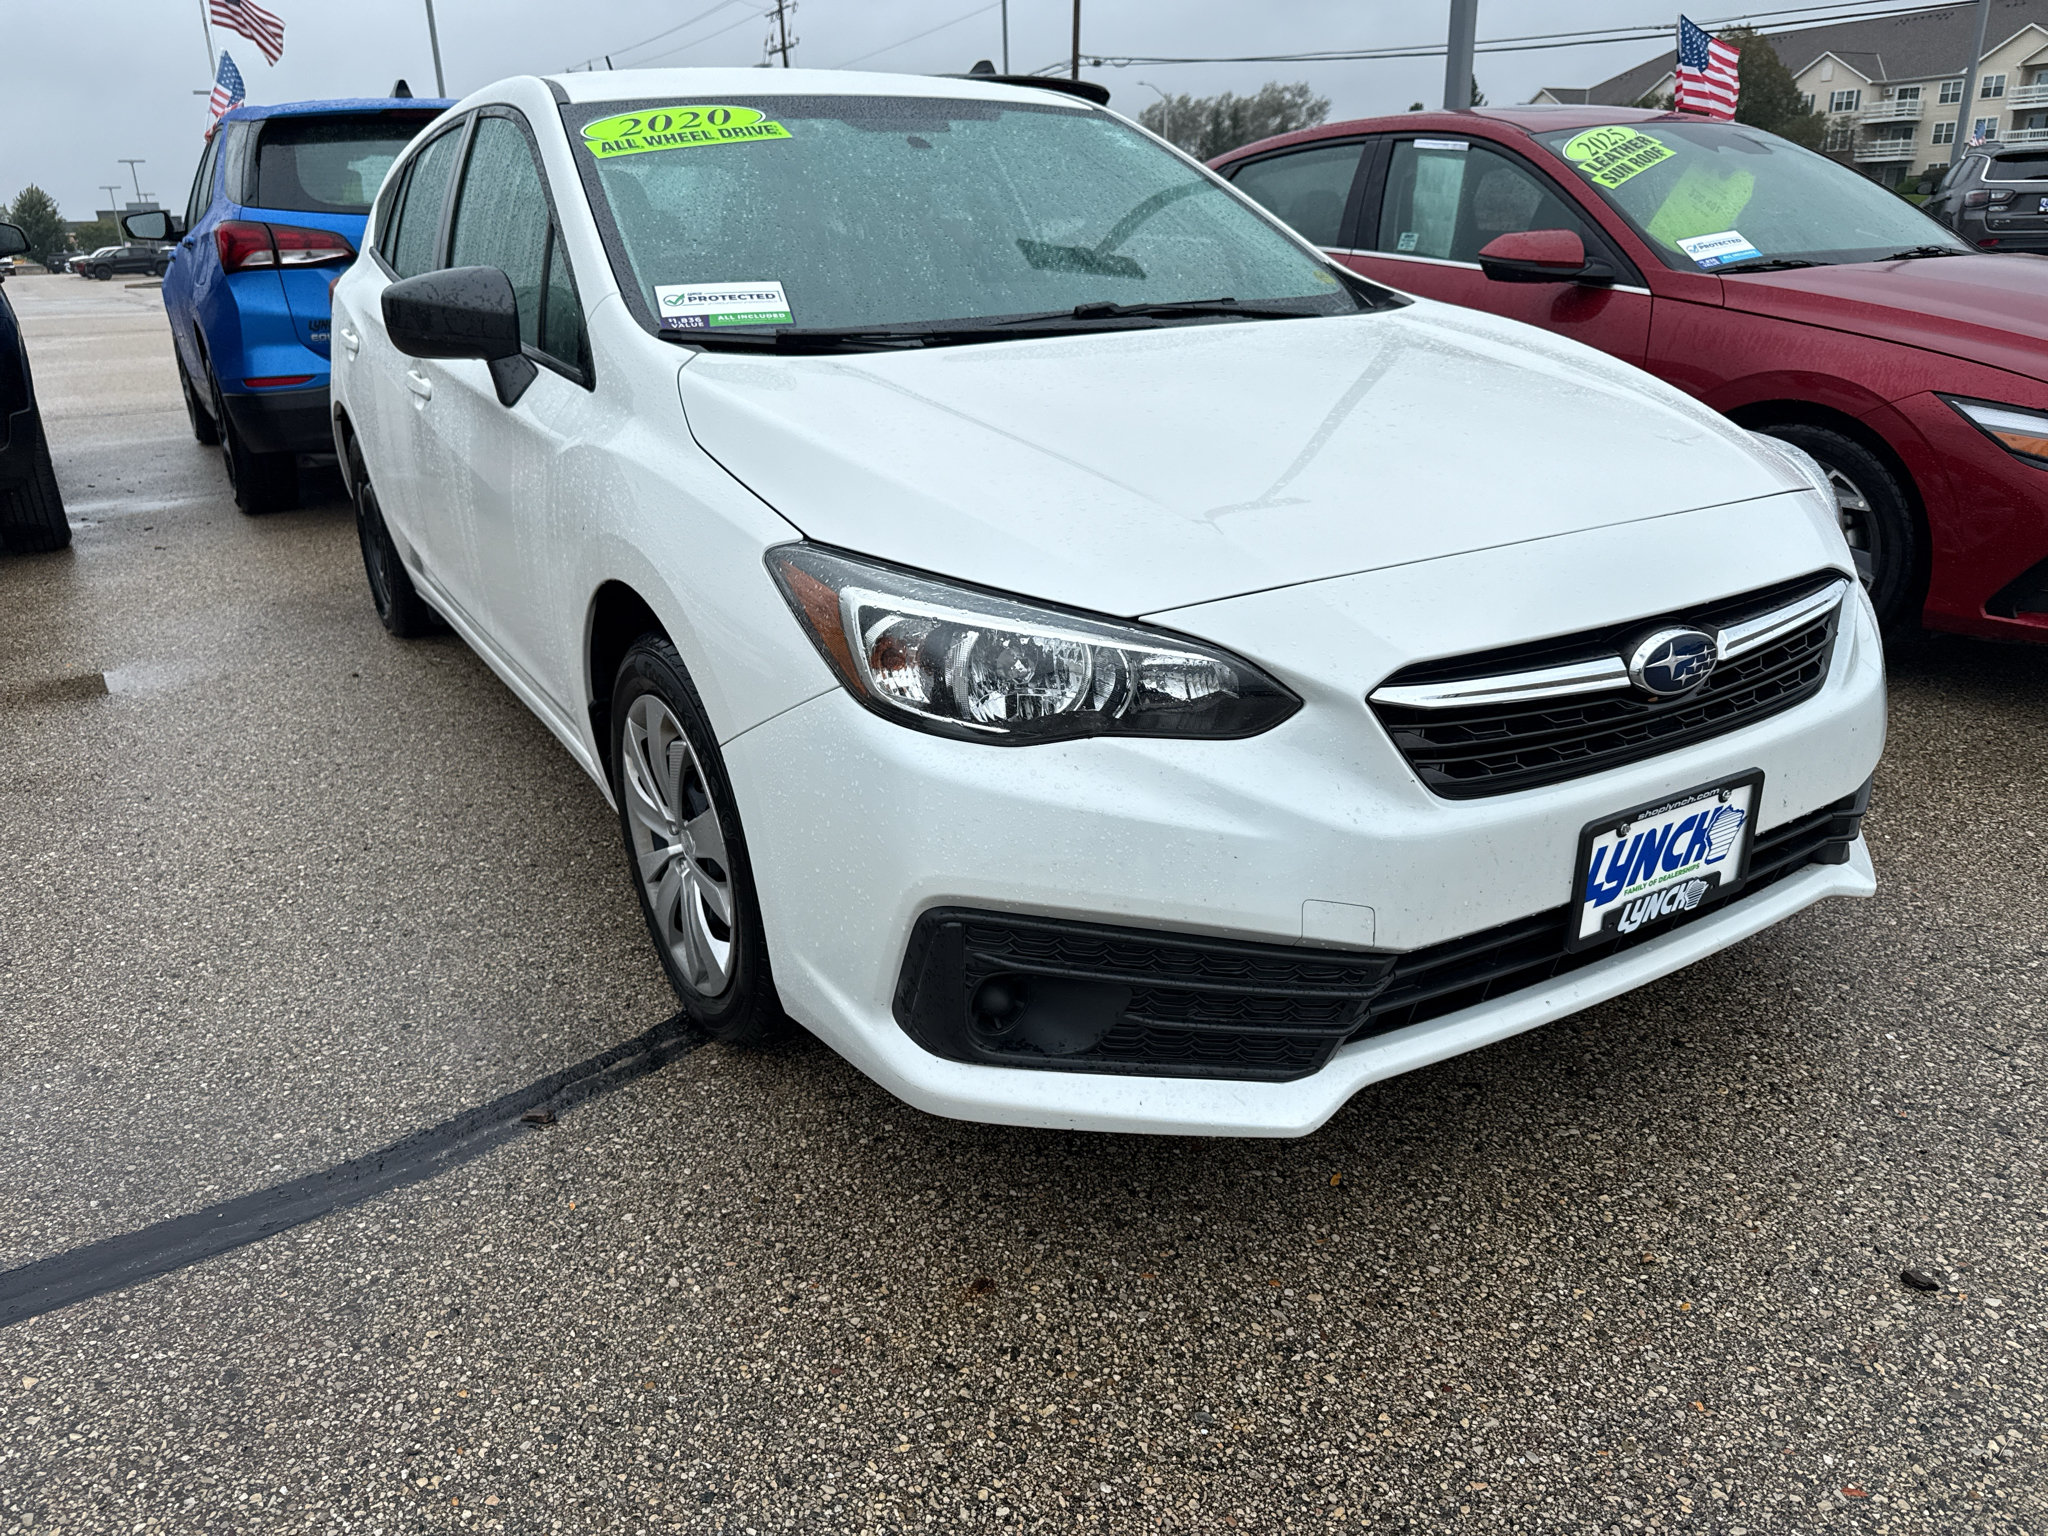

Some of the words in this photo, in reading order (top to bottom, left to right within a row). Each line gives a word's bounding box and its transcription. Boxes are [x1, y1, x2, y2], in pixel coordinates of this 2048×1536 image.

[618, 108, 732, 138] 2020
[601, 138, 640, 153] ALL
[643, 130, 713, 148] WHEEL
[717, 124, 777, 139] DRIVE
[1577, 128, 1627, 157] 2025
[1585, 136, 1654, 172] LEATHER
[1600, 162, 1638, 184] SUN
[1627, 146, 1666, 169] ROOF
[1698, 238, 1742, 250] PROTECTED
[687, 293, 776, 303] PROTECTED
[670, 319, 704, 328] VALUE
[737, 312, 786, 320] INCLUDED
[1637, 788, 1720, 820] shoplynch.com
[1585, 805, 1724, 908] LYNCH
[1623, 882, 1648, 896] FAMILY
[1648, 878, 1658, 887] OF
[1658, 863, 1701, 884] DEALERSHIPS
[1617, 879, 1692, 934] LYNCH
